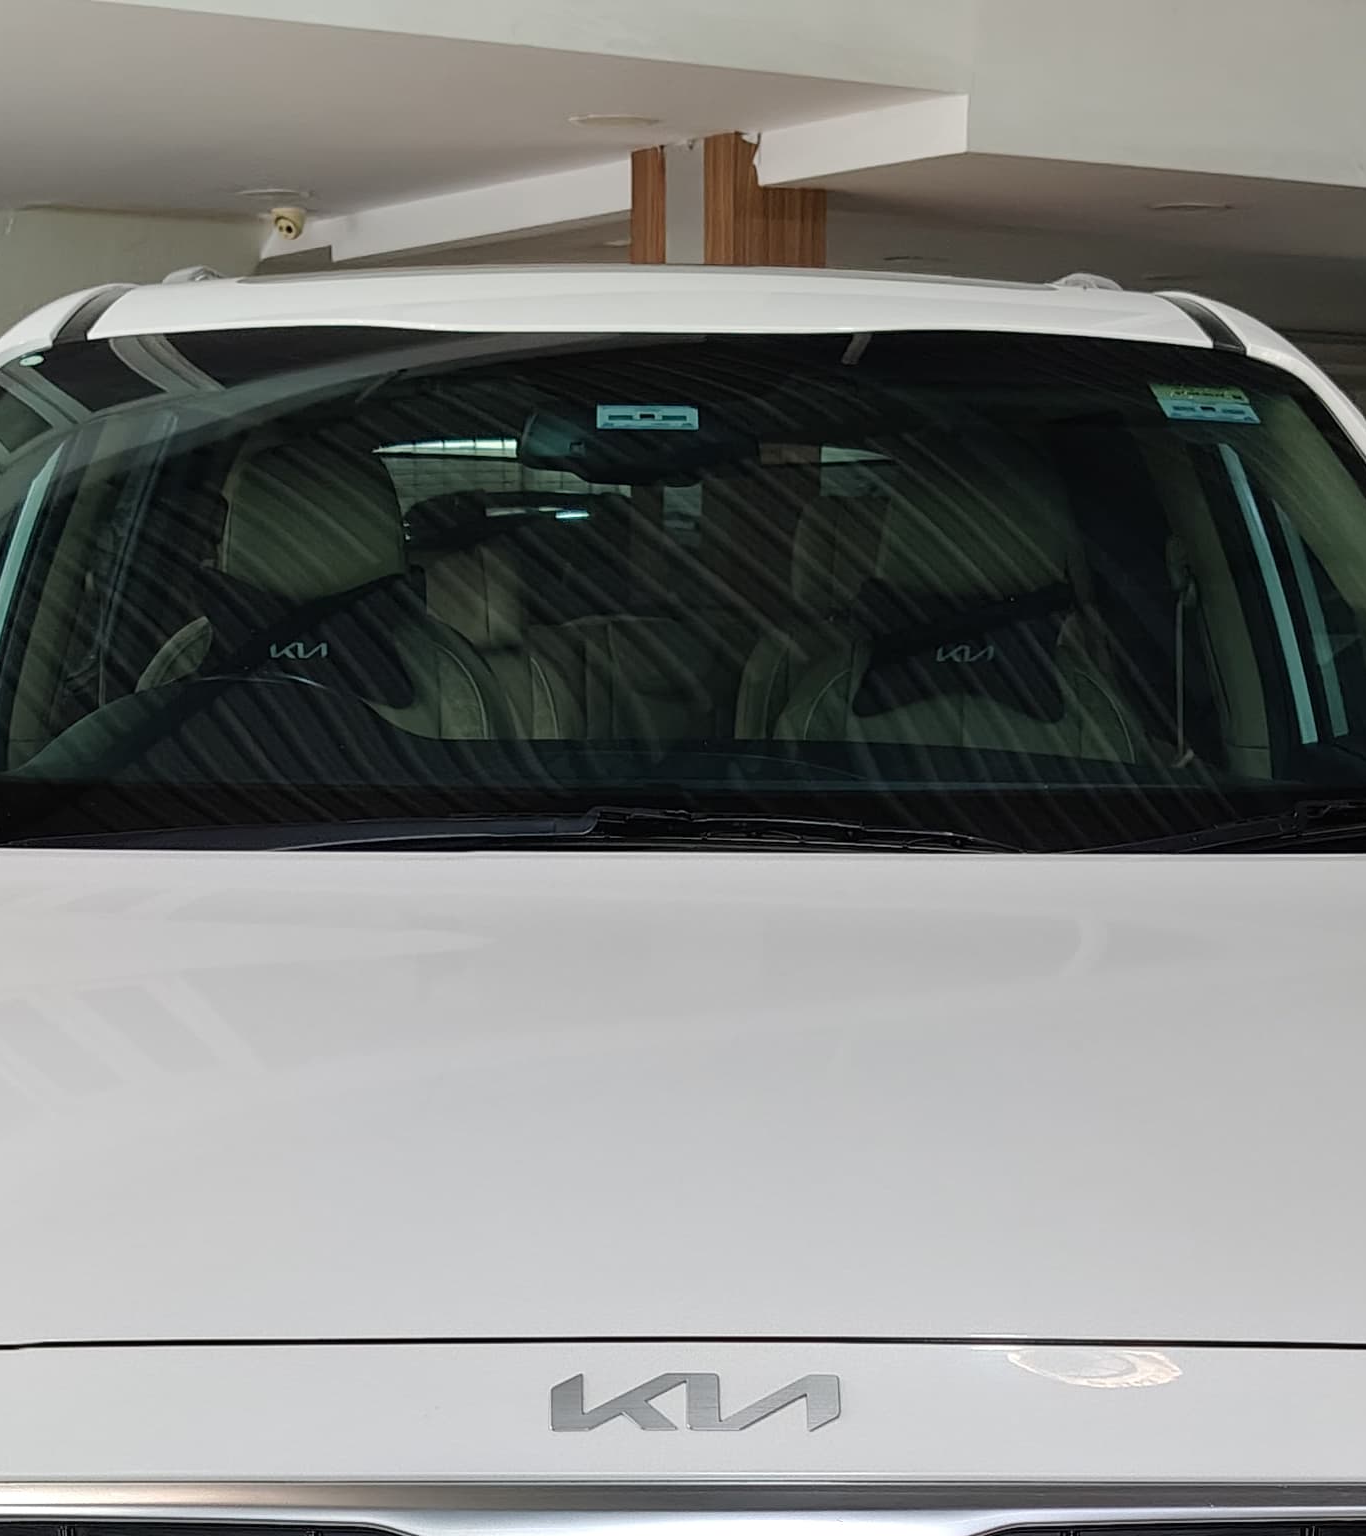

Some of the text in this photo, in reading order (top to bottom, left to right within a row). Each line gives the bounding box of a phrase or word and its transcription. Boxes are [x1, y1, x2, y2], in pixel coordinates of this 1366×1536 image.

[270, 642, 328, 659] KIA
[936, 644, 994, 662] KIA
[549, 1372, 842, 1432] KIA
